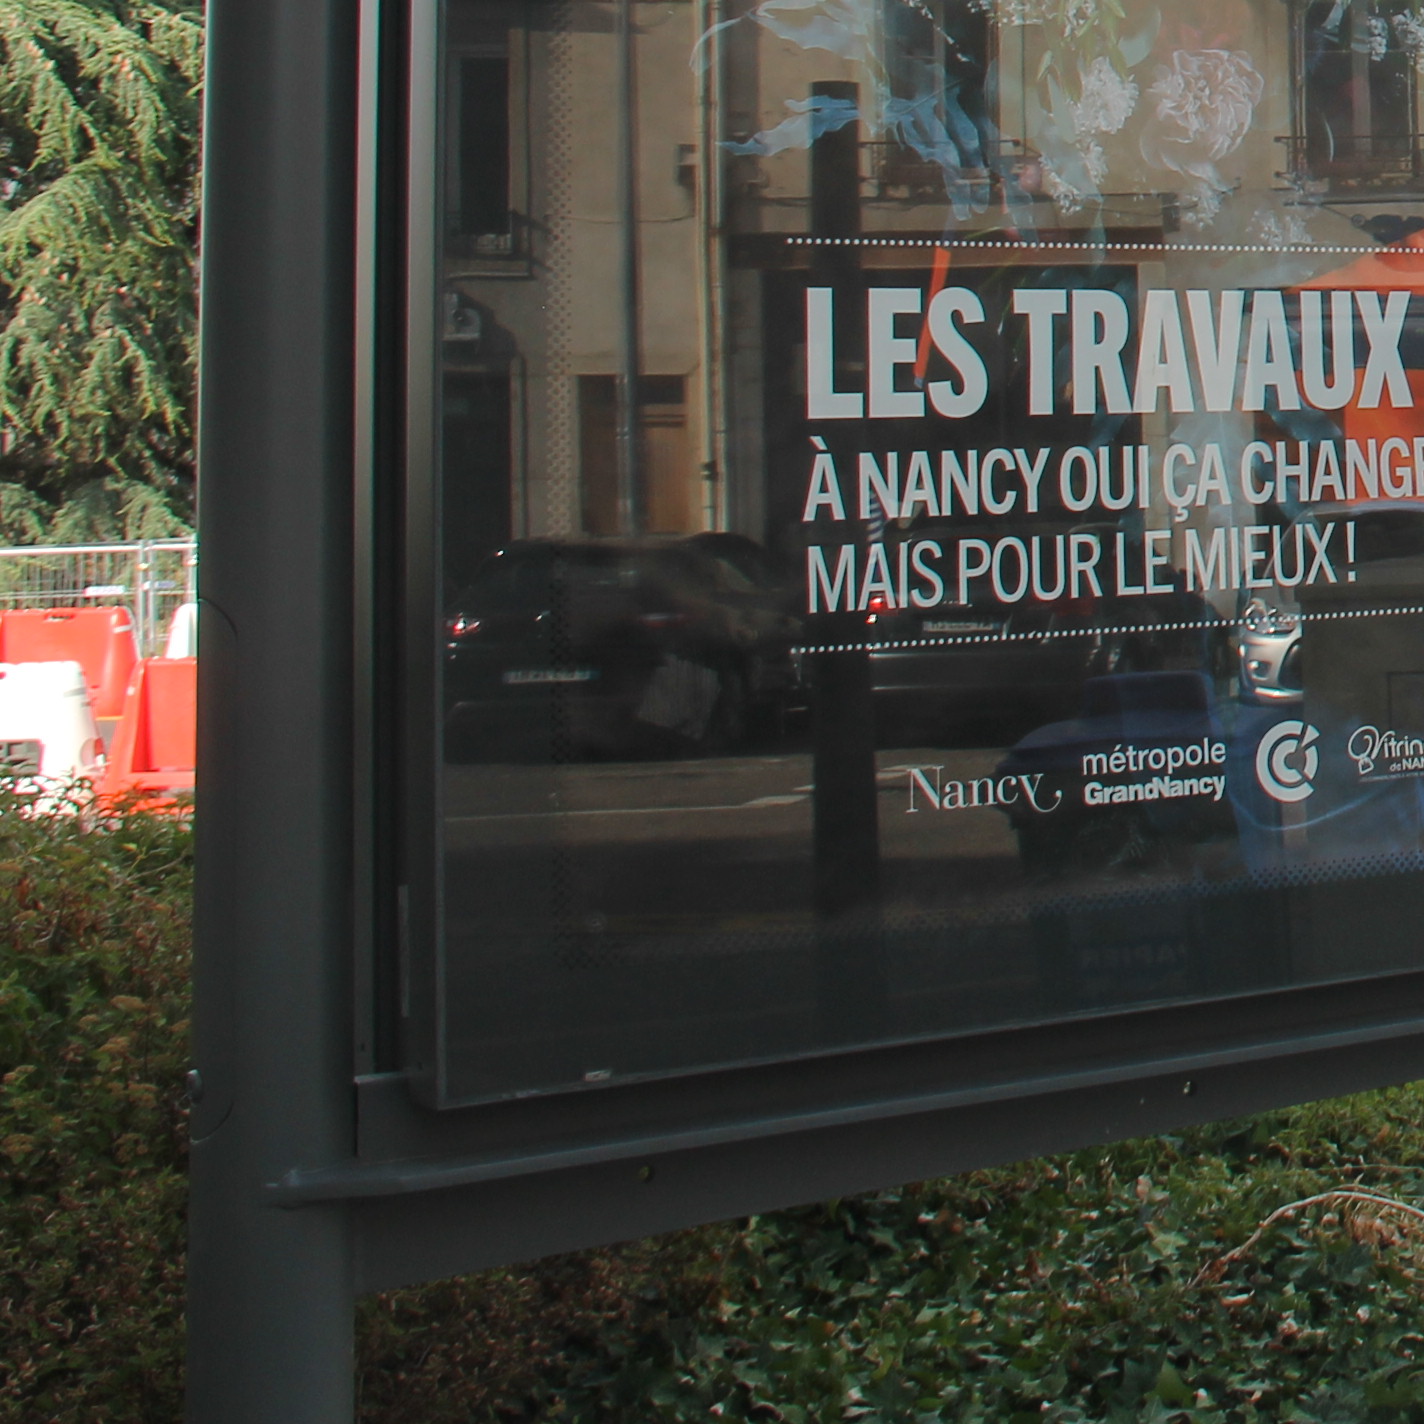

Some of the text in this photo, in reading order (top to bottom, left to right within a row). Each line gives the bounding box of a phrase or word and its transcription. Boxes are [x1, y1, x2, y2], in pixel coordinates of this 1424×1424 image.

[806, 286, 988, 419] LES
[1013, 289, 1413, 416] TRAVAUX
[803, 436, 845, 522] À
[859, 446, 1051, 520] NANCY
[1059, 444, 1150, 511] OUI
[1162, 441, 1232, 522] ÇA
[807, 538, 944, 615] MAIS
[958, 532, 1103, 606] POUR
[1116, 528, 1175, 597] LE
[906, 765, 1063, 814] Nancy
[1083, 737, 1227, 777] métropole
[1083, 774, 1227, 805] GrandNancy
